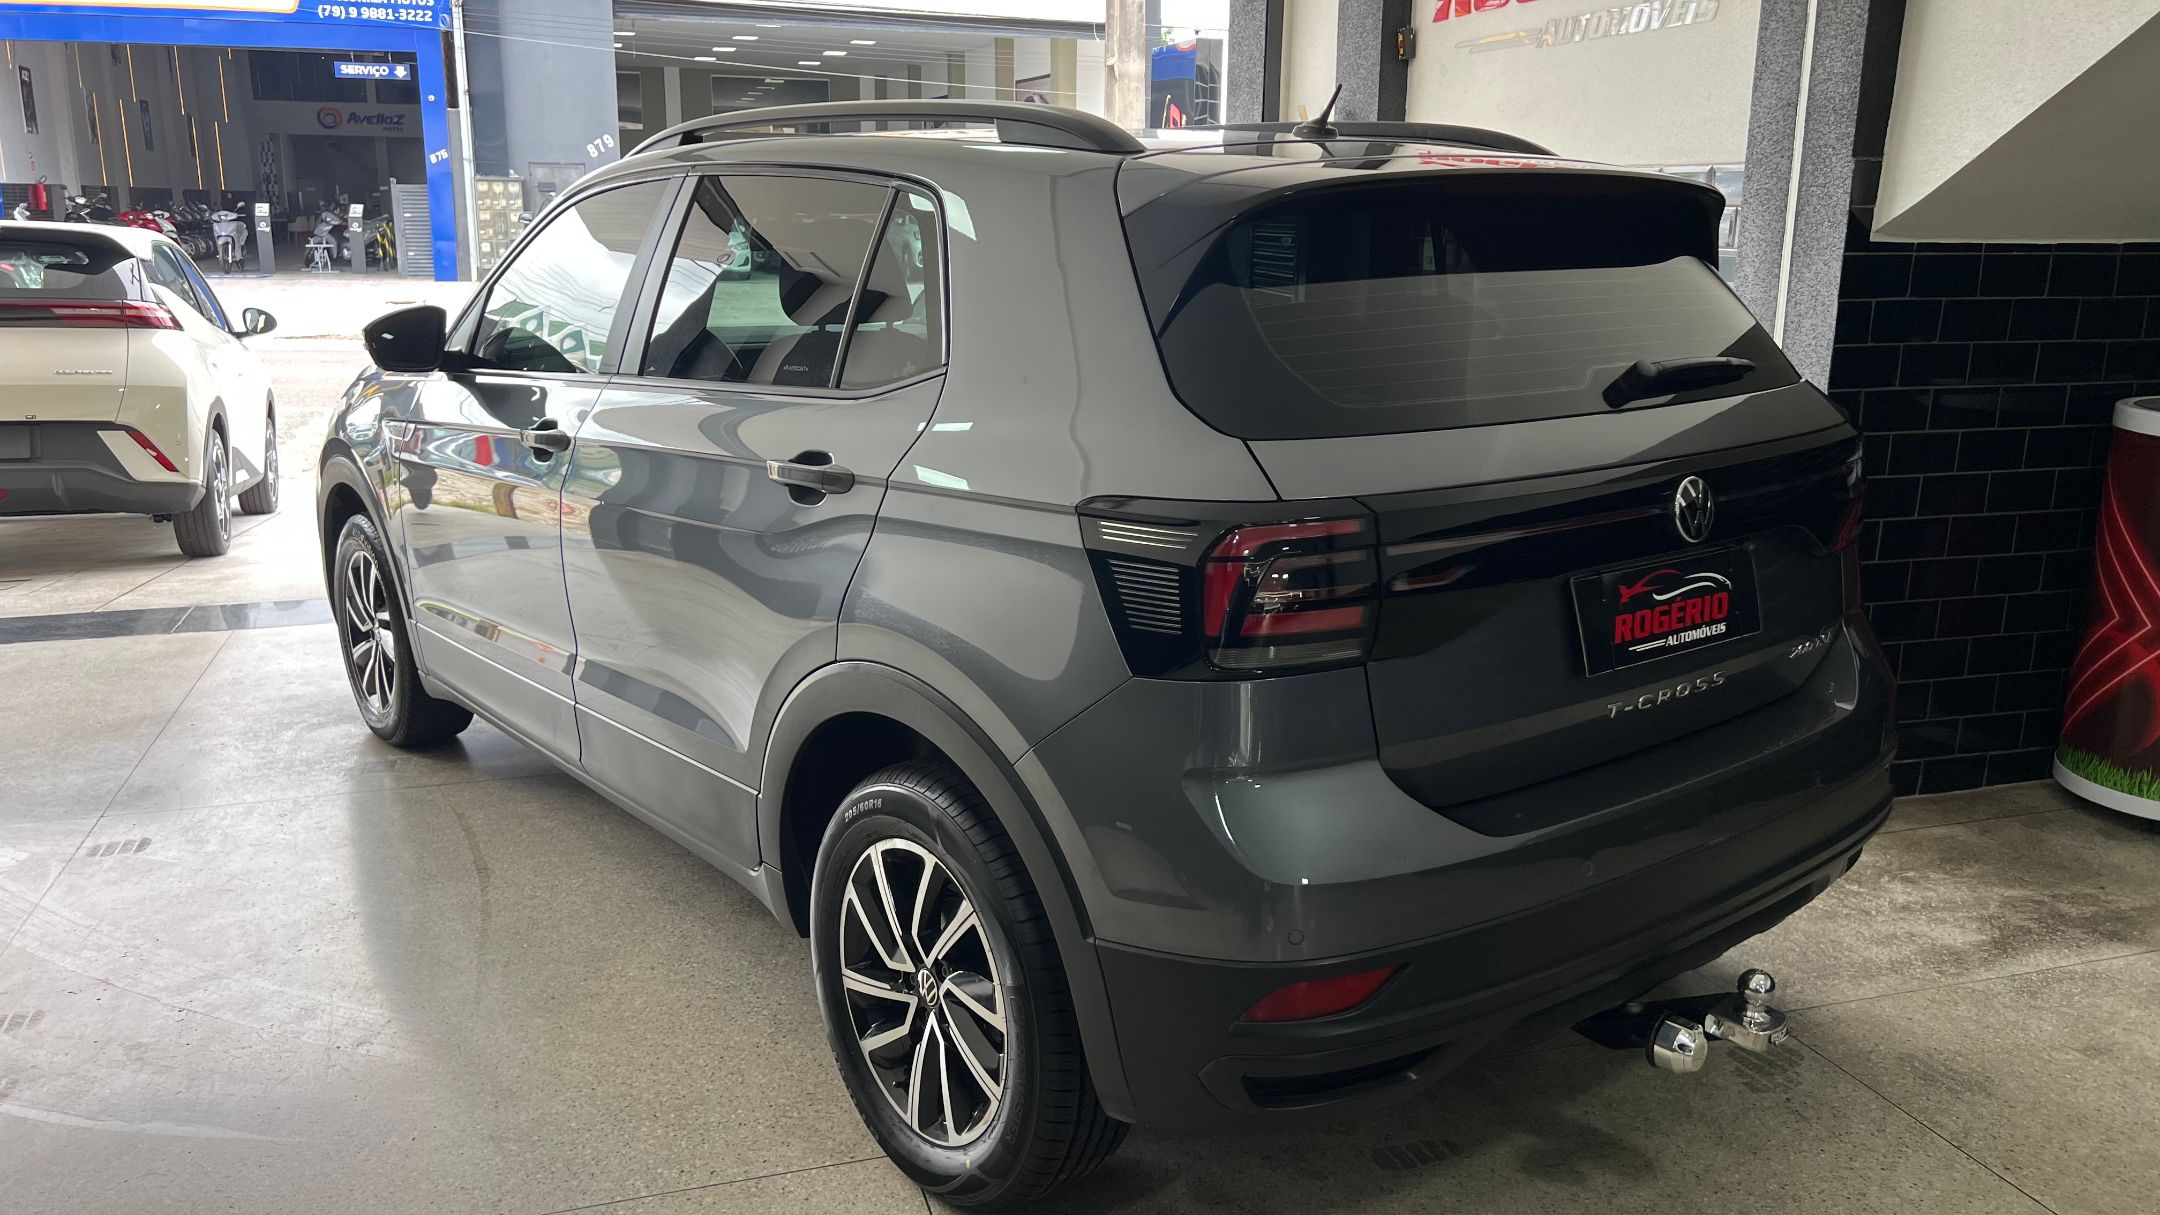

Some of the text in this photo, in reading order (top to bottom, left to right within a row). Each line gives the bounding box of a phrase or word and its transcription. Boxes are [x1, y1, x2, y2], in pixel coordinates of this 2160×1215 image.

[317, 4, 433, 22] (79) 9 9881-3222
[340, 64, 389, 78] SERVIÇO
[586, 133, 614, 158] 879
[1614, 591, 1729, 645] ROGÉRIO
[1665, 621, 1727, 647] AUTOMÓVEIS
[1607, 670, 1725, 719] T-CROSS
[844, 797, 883, 823] 205/60R16
